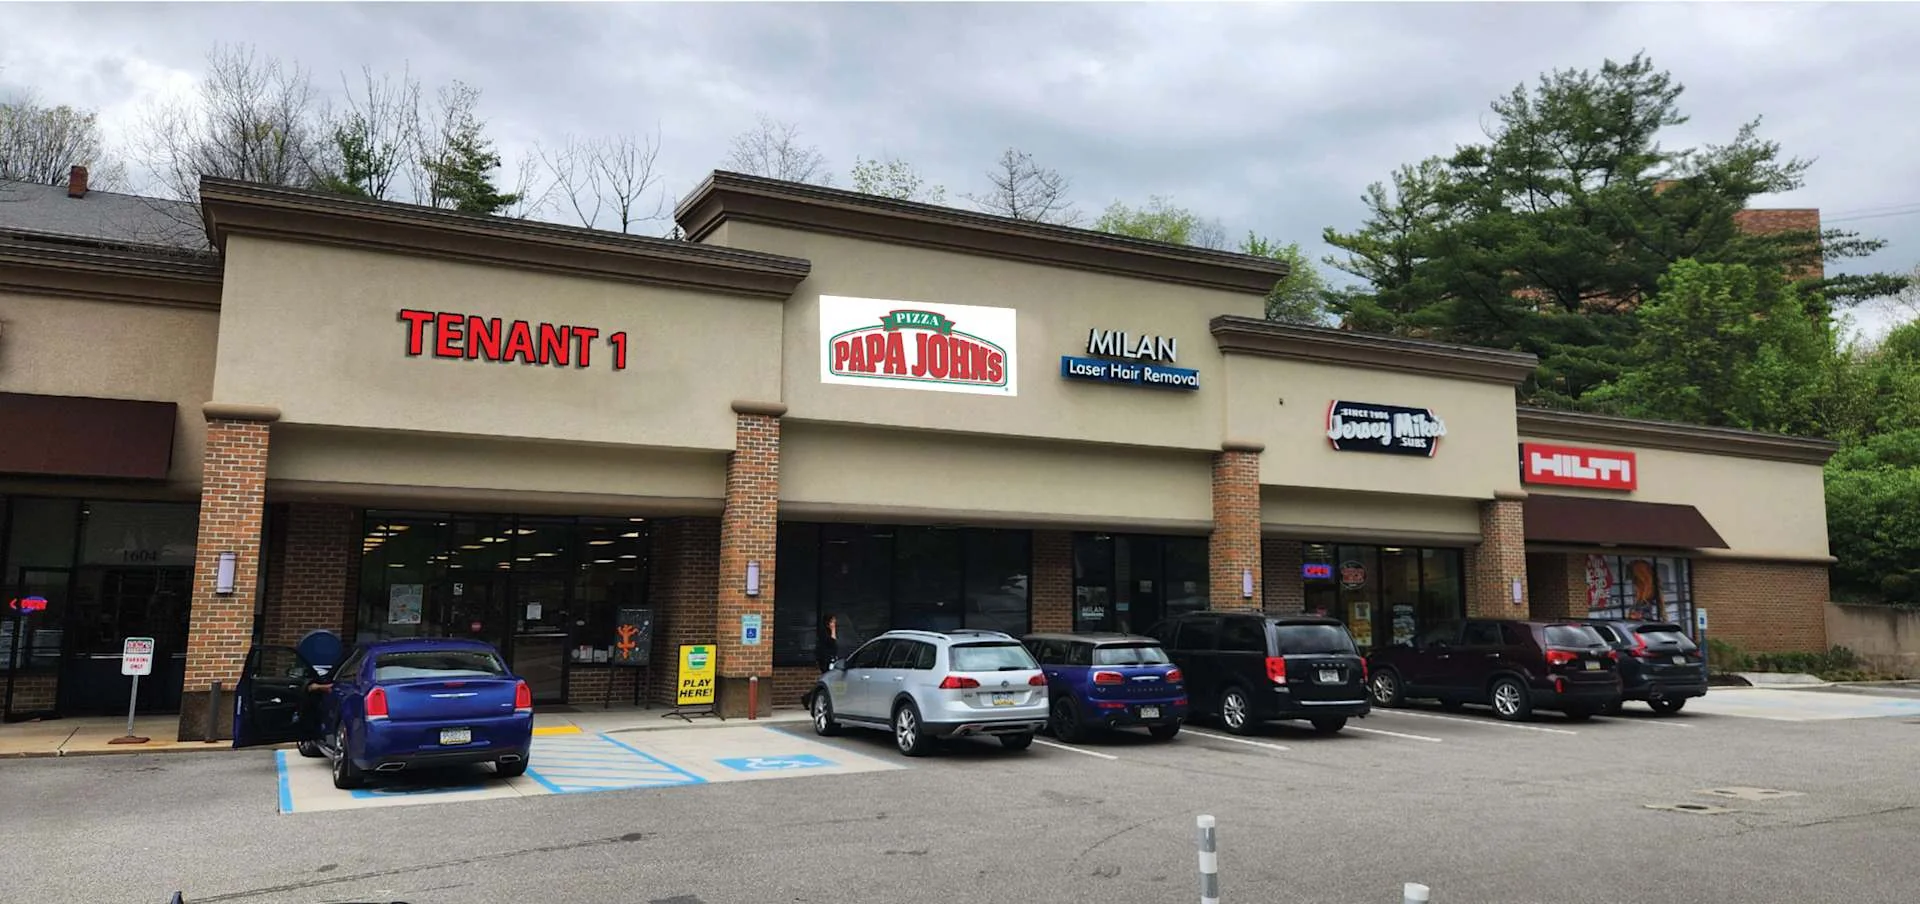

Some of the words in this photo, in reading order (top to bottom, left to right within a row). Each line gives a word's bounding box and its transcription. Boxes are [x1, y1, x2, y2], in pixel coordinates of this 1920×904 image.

[896, 313, 940, 326] PIZZA
[400, 308, 599, 367] TENANT
[610, 331, 627, 369] 1
[1088, 328, 1176, 363] MILAN
[835, 332, 907, 375] PAPA
[911, 333, 1002, 382] JOHN'S
[1069, 359, 1106, 377] Laser
[1110, 363, 1140, 380] Hair
[1144, 367, 1200, 387] Removal
[1340, 408, 1369, 418] SINCE
[1327, 414, 1393, 446] Jersey
[1393, 412, 1447, 438] Mike's
[1400, 437, 1427, 448] SUBS
[1531, 452, 1631, 482] HILTI
[680, 688, 713, 698] HERE!
[683, 679, 712, 688] PLAY
